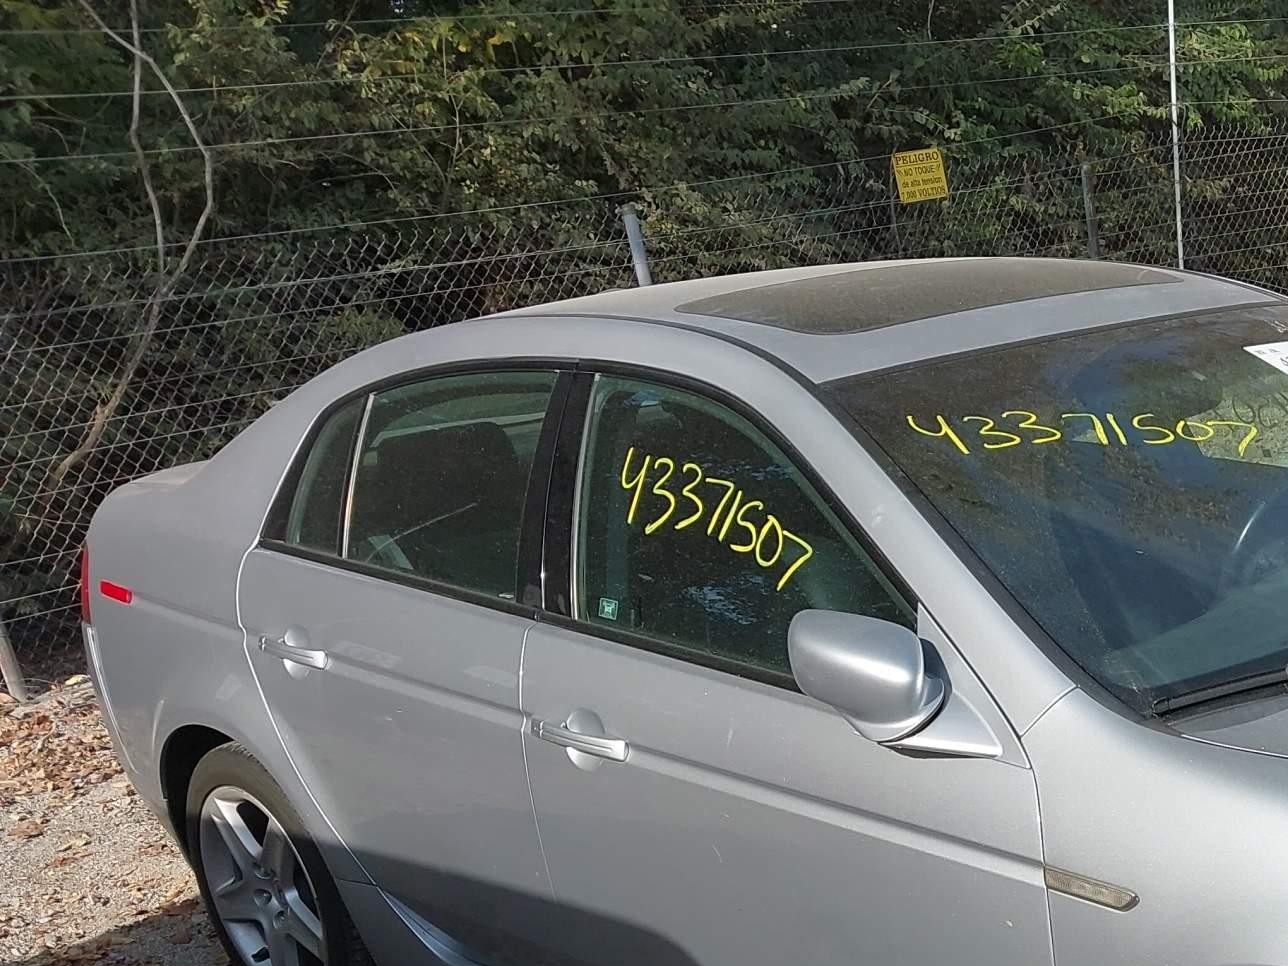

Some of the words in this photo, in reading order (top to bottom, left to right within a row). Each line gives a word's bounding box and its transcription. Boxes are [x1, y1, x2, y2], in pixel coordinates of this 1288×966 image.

[896, 152, 938, 165] PELIGRO
[904, 168, 913, 177] NO
[914, 165, 935, 176] TOQUE
[918, 185, 946, 198] VOLTIOS
[907, 411, 1257, 456] 43371507
[621, 447, 813, 591] 43371507
